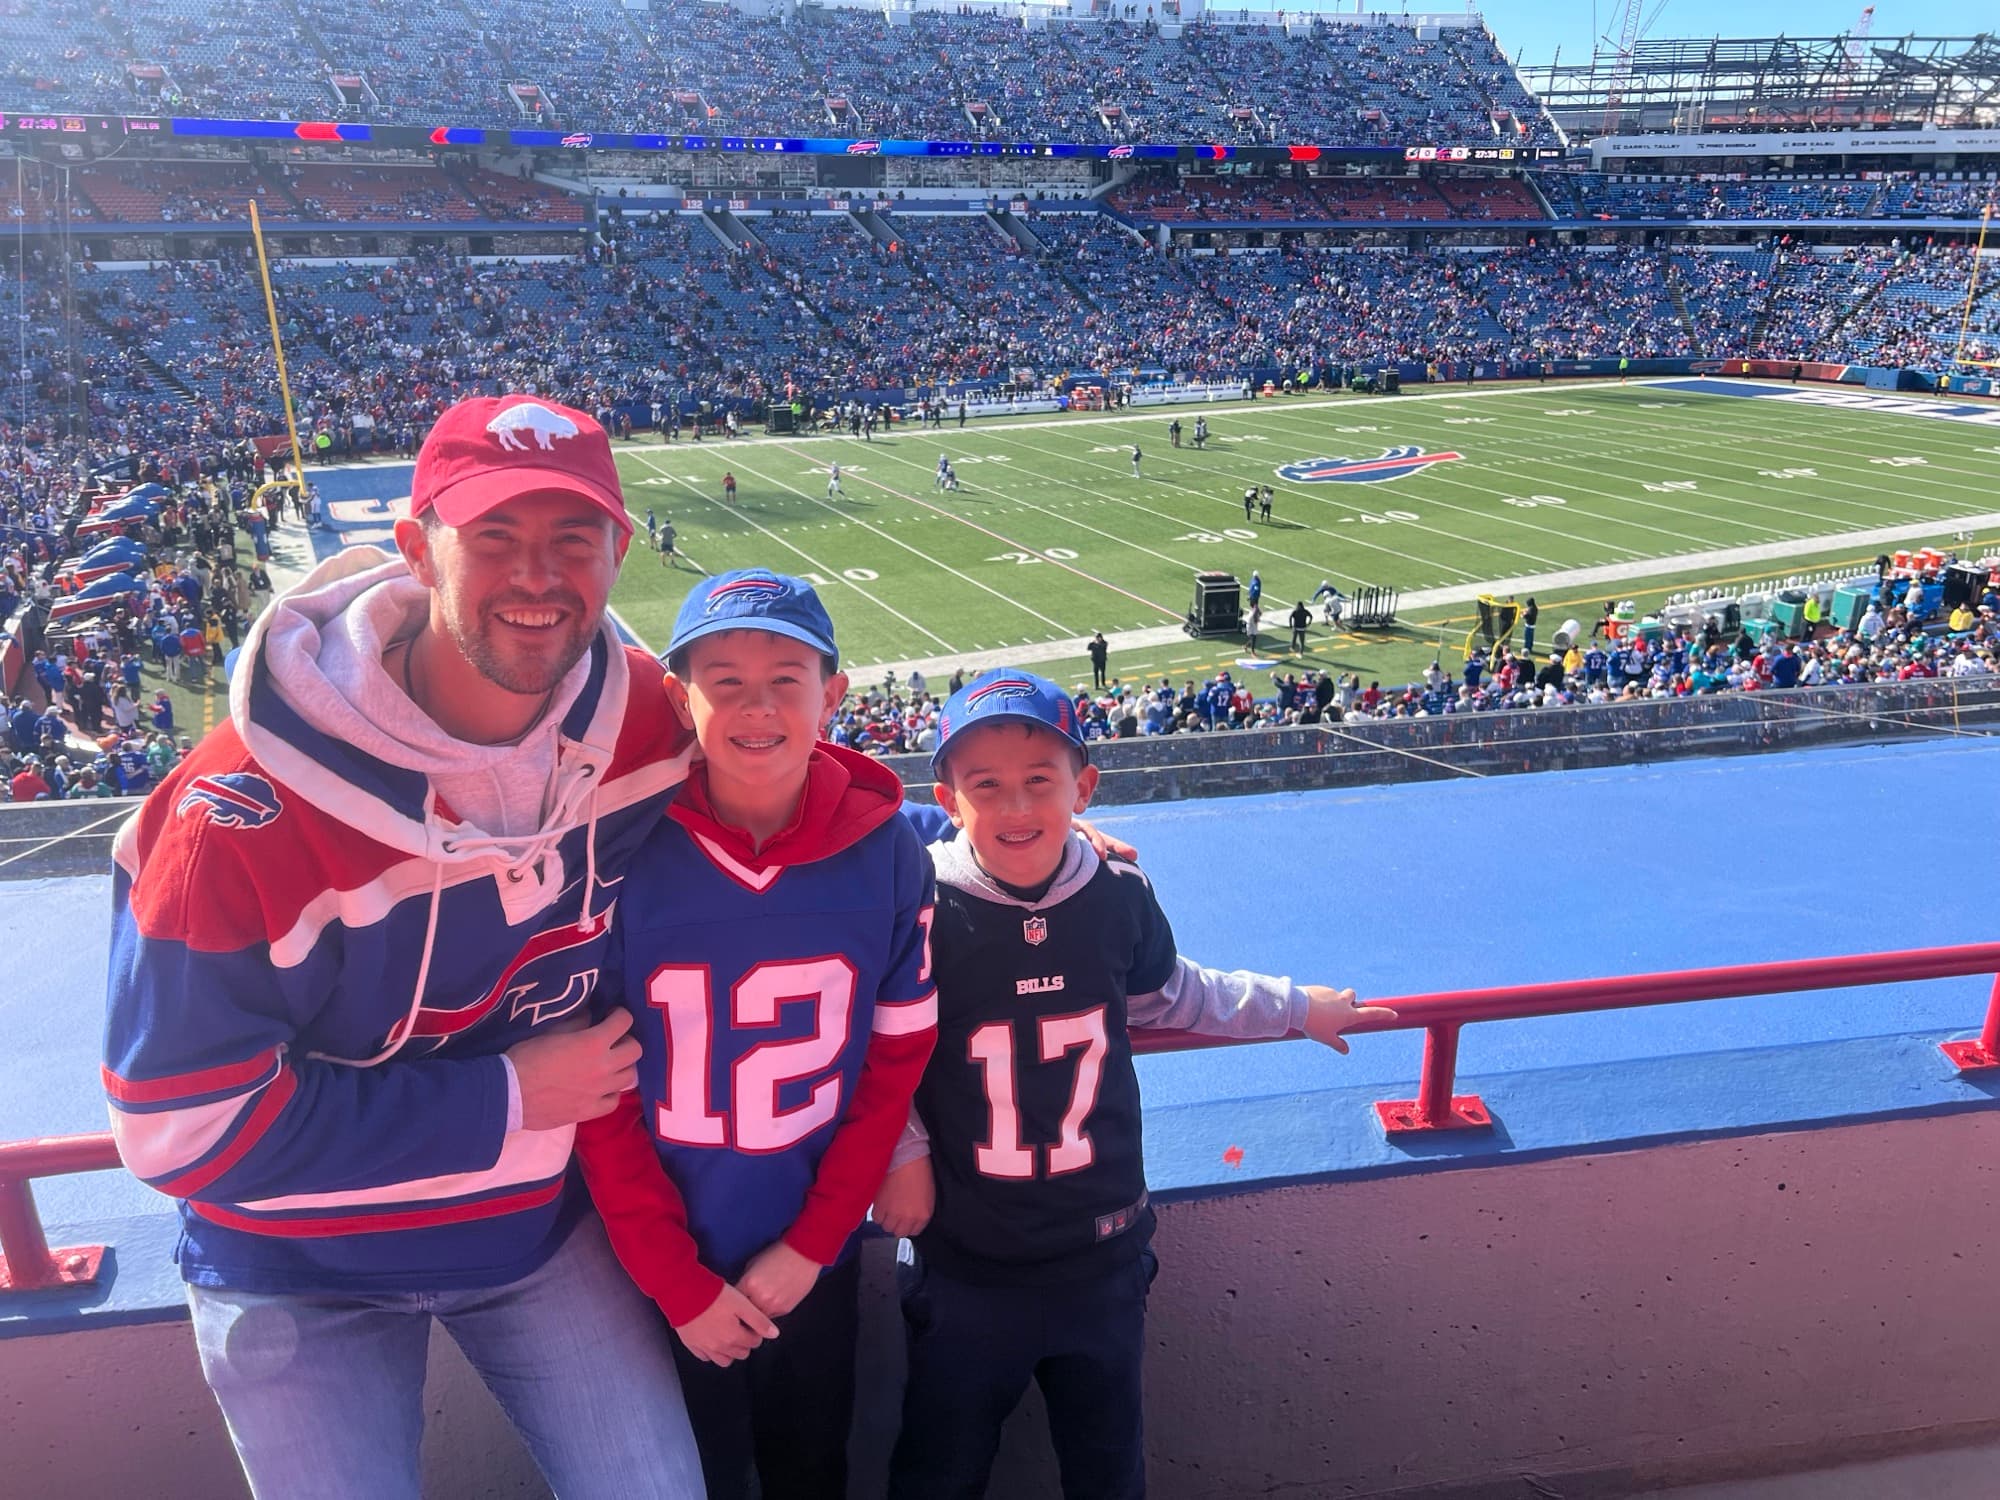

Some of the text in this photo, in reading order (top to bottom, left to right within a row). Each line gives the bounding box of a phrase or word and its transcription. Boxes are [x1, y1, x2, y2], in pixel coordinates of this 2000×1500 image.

[686, 200, 703, 209] 132
[728, 200, 745, 209] 133
[833, 200, 849, 210] 133
[1500, 494, 1568, 508] 50
[1359, 510, 1421, 524] 40
[1186, 527, 1259, 543] 30
[1000, 547, 1080, 565] 20
[798, 567, 880, 586] 10
[1217, 694, 1229, 707] 17
[1028, 928, 1044, 941] NFL
[1015, 975, 1065, 996] BILLS
[645, 952, 859, 1156] 12
[966, 1003, 1109, 1180] 17
